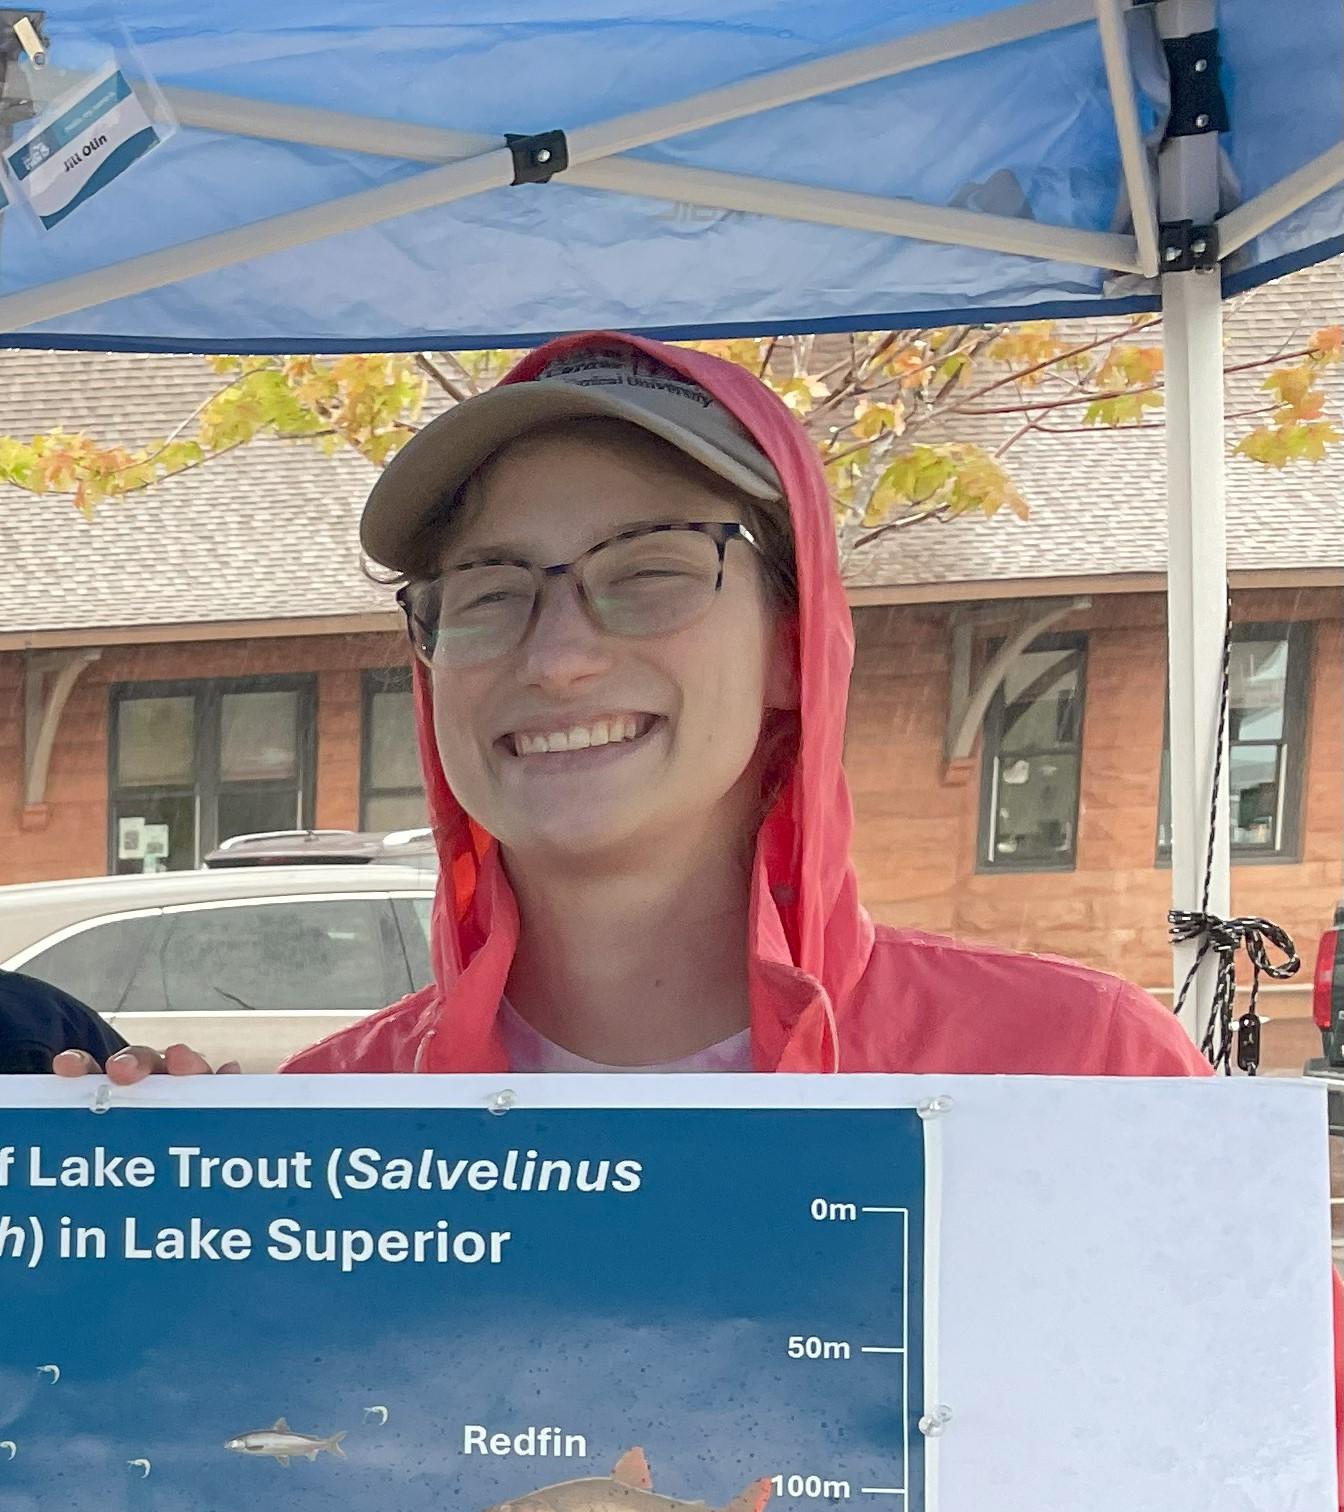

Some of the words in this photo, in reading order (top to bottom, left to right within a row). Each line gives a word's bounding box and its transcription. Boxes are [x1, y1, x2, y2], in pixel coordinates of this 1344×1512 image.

[64, 153, 82, 172] Jill
[82, 134, 108, 156] Olin
[30, 1146, 155, 1188] Lake
[168, 1146, 312, 1189] Trout
[327, 1147, 643, 1200] (Salvelinus
[810, 1198, 857, 1221] 0m
[61, 1216, 106, 1259] in
[125, 1217, 252, 1261] Lake
[267, 1218, 511, 1272] Superior
[787, 1335, 851, 1360] 50m
[463, 1425, 587, 1458] Redfin
[770, 1474, 851, 1499] 100m
